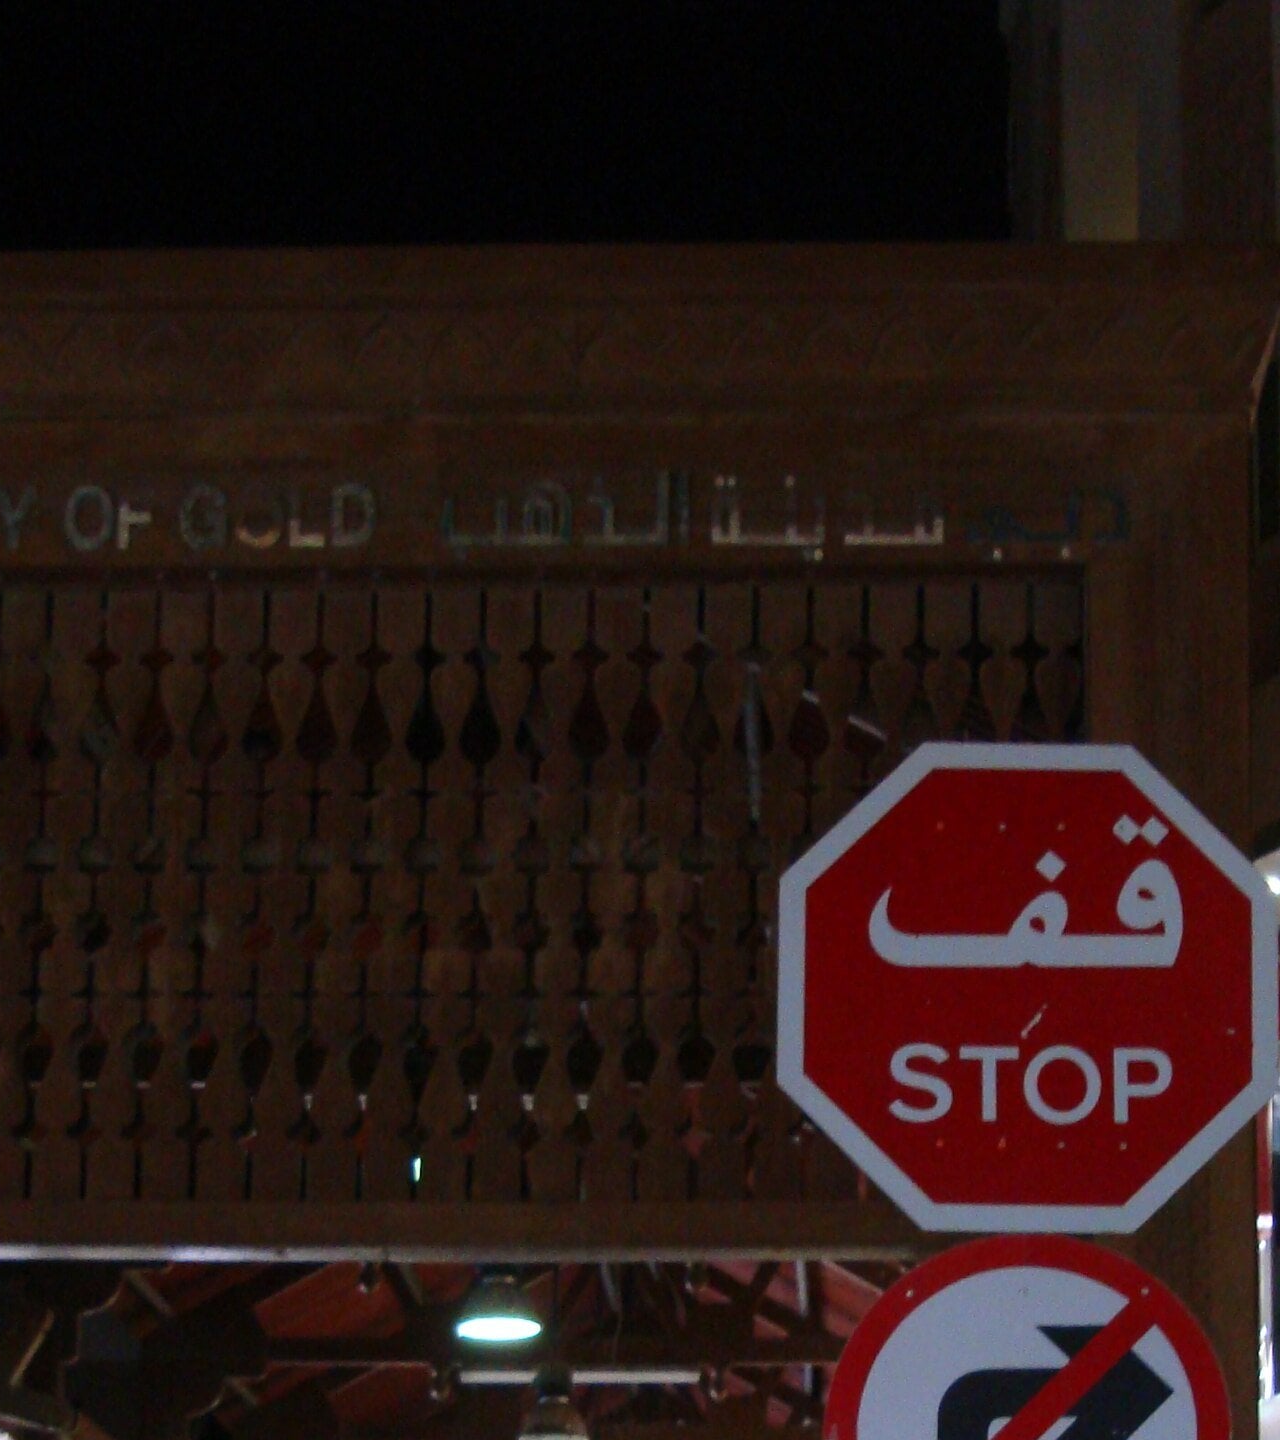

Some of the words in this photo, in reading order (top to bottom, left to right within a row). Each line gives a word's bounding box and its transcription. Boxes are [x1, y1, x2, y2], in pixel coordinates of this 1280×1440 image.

[65, 484, 152, 553] OF
[179, 483, 376, 553] GOLD
[440, 470, 690, 560] الذهب
[868, 814, 1184, 968] قف
[887, 1042, 1173, 1126] STOP
